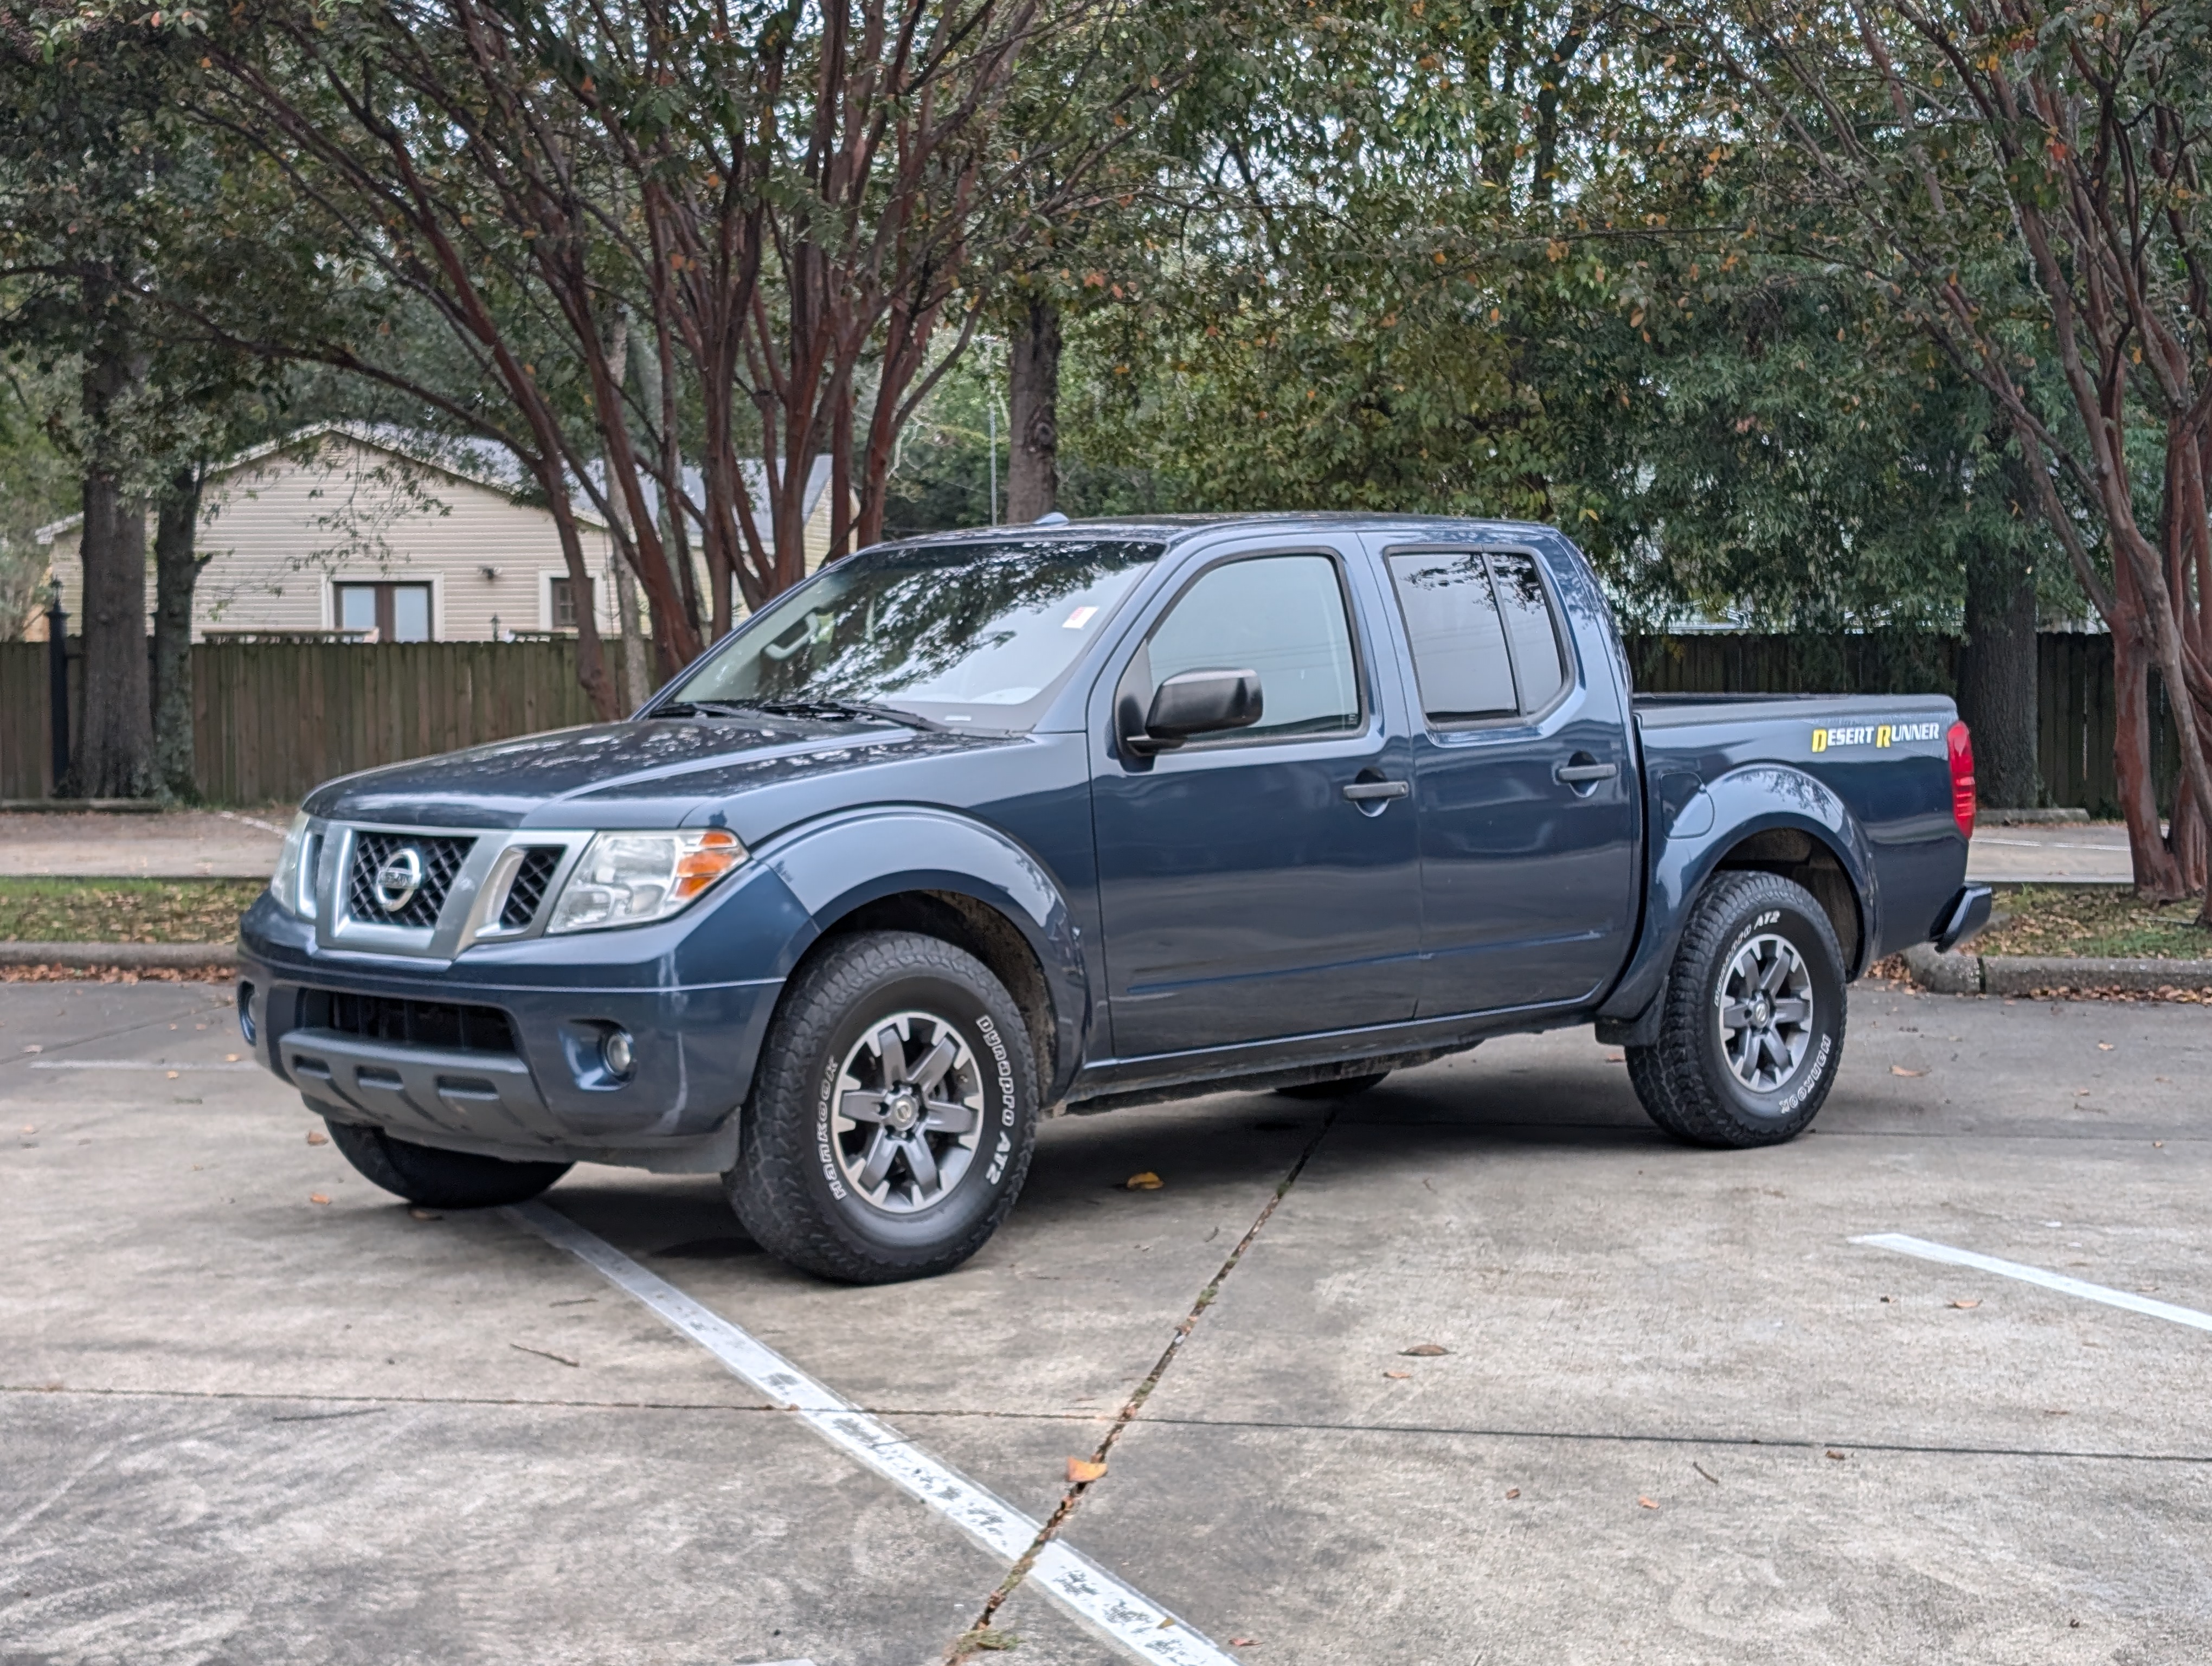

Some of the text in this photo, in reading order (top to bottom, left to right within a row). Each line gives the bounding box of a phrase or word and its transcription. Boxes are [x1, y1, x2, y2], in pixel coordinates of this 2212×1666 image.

[1812, 722, 1939, 753] DESERT RUNNER
[1754, 910, 1780, 930] AT2
[986, 1131, 1011, 1184] AT2
